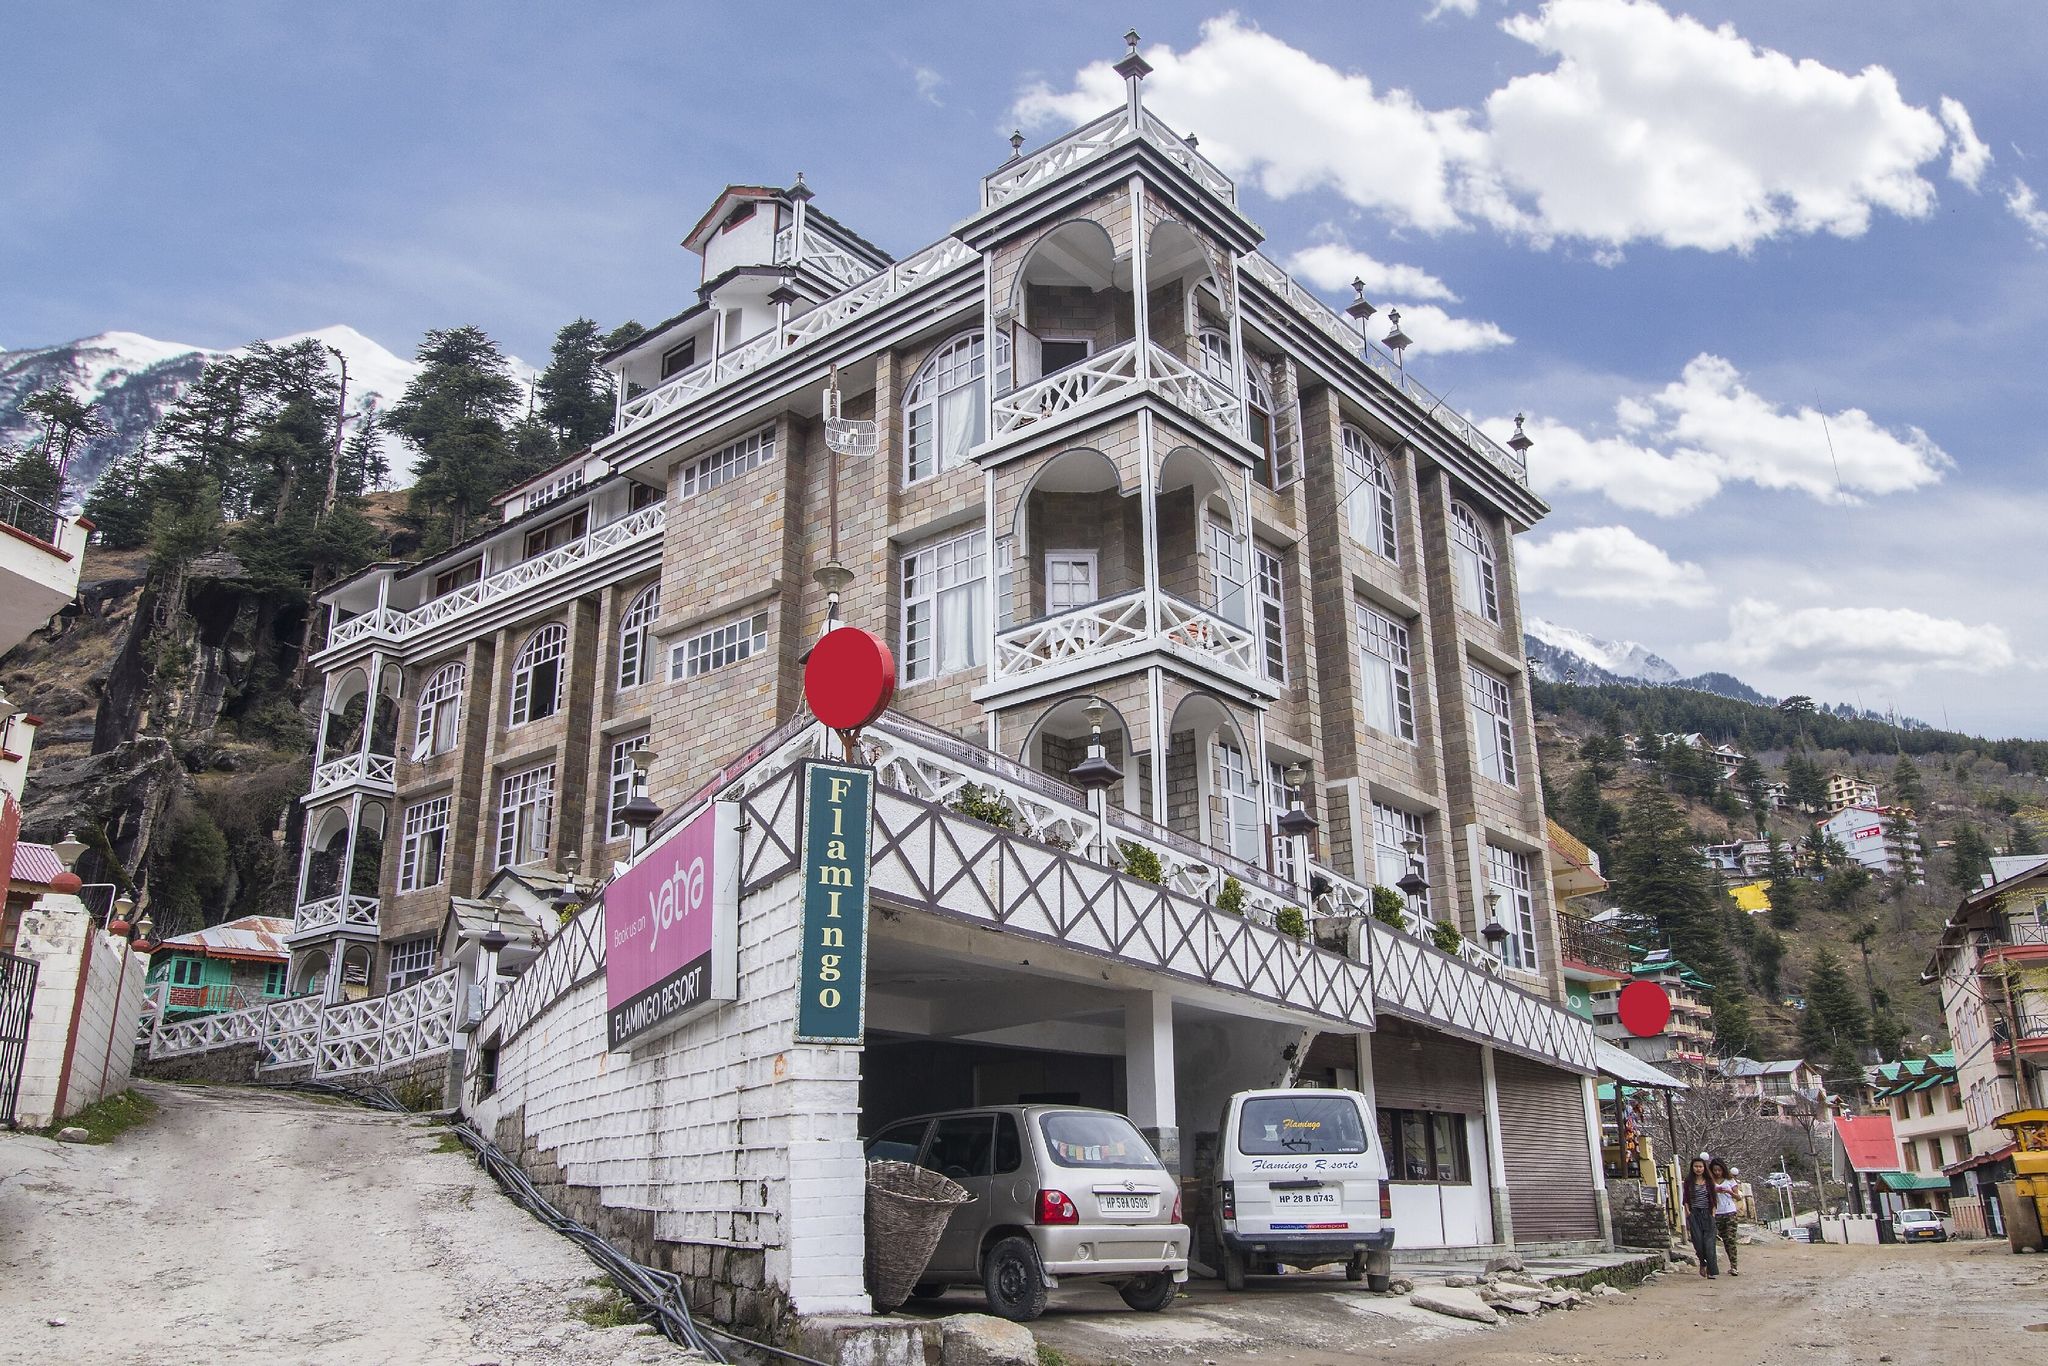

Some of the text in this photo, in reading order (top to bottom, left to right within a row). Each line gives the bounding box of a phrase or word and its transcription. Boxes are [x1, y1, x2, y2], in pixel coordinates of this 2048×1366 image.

[649, 856, 704, 953] yatra
[614, 915, 646, 948] Book us on
[615, 966, 702, 1042] FLAMINGO RESORT
[1282, 1118, 1321, 1130] Flamingo
[1251, 1159, 1359, 1173] Flamingo Rsorts
[1106, 1197, 1115, 1208] HP
[1279, 1194, 1334, 1203] HP 28 B 0743
